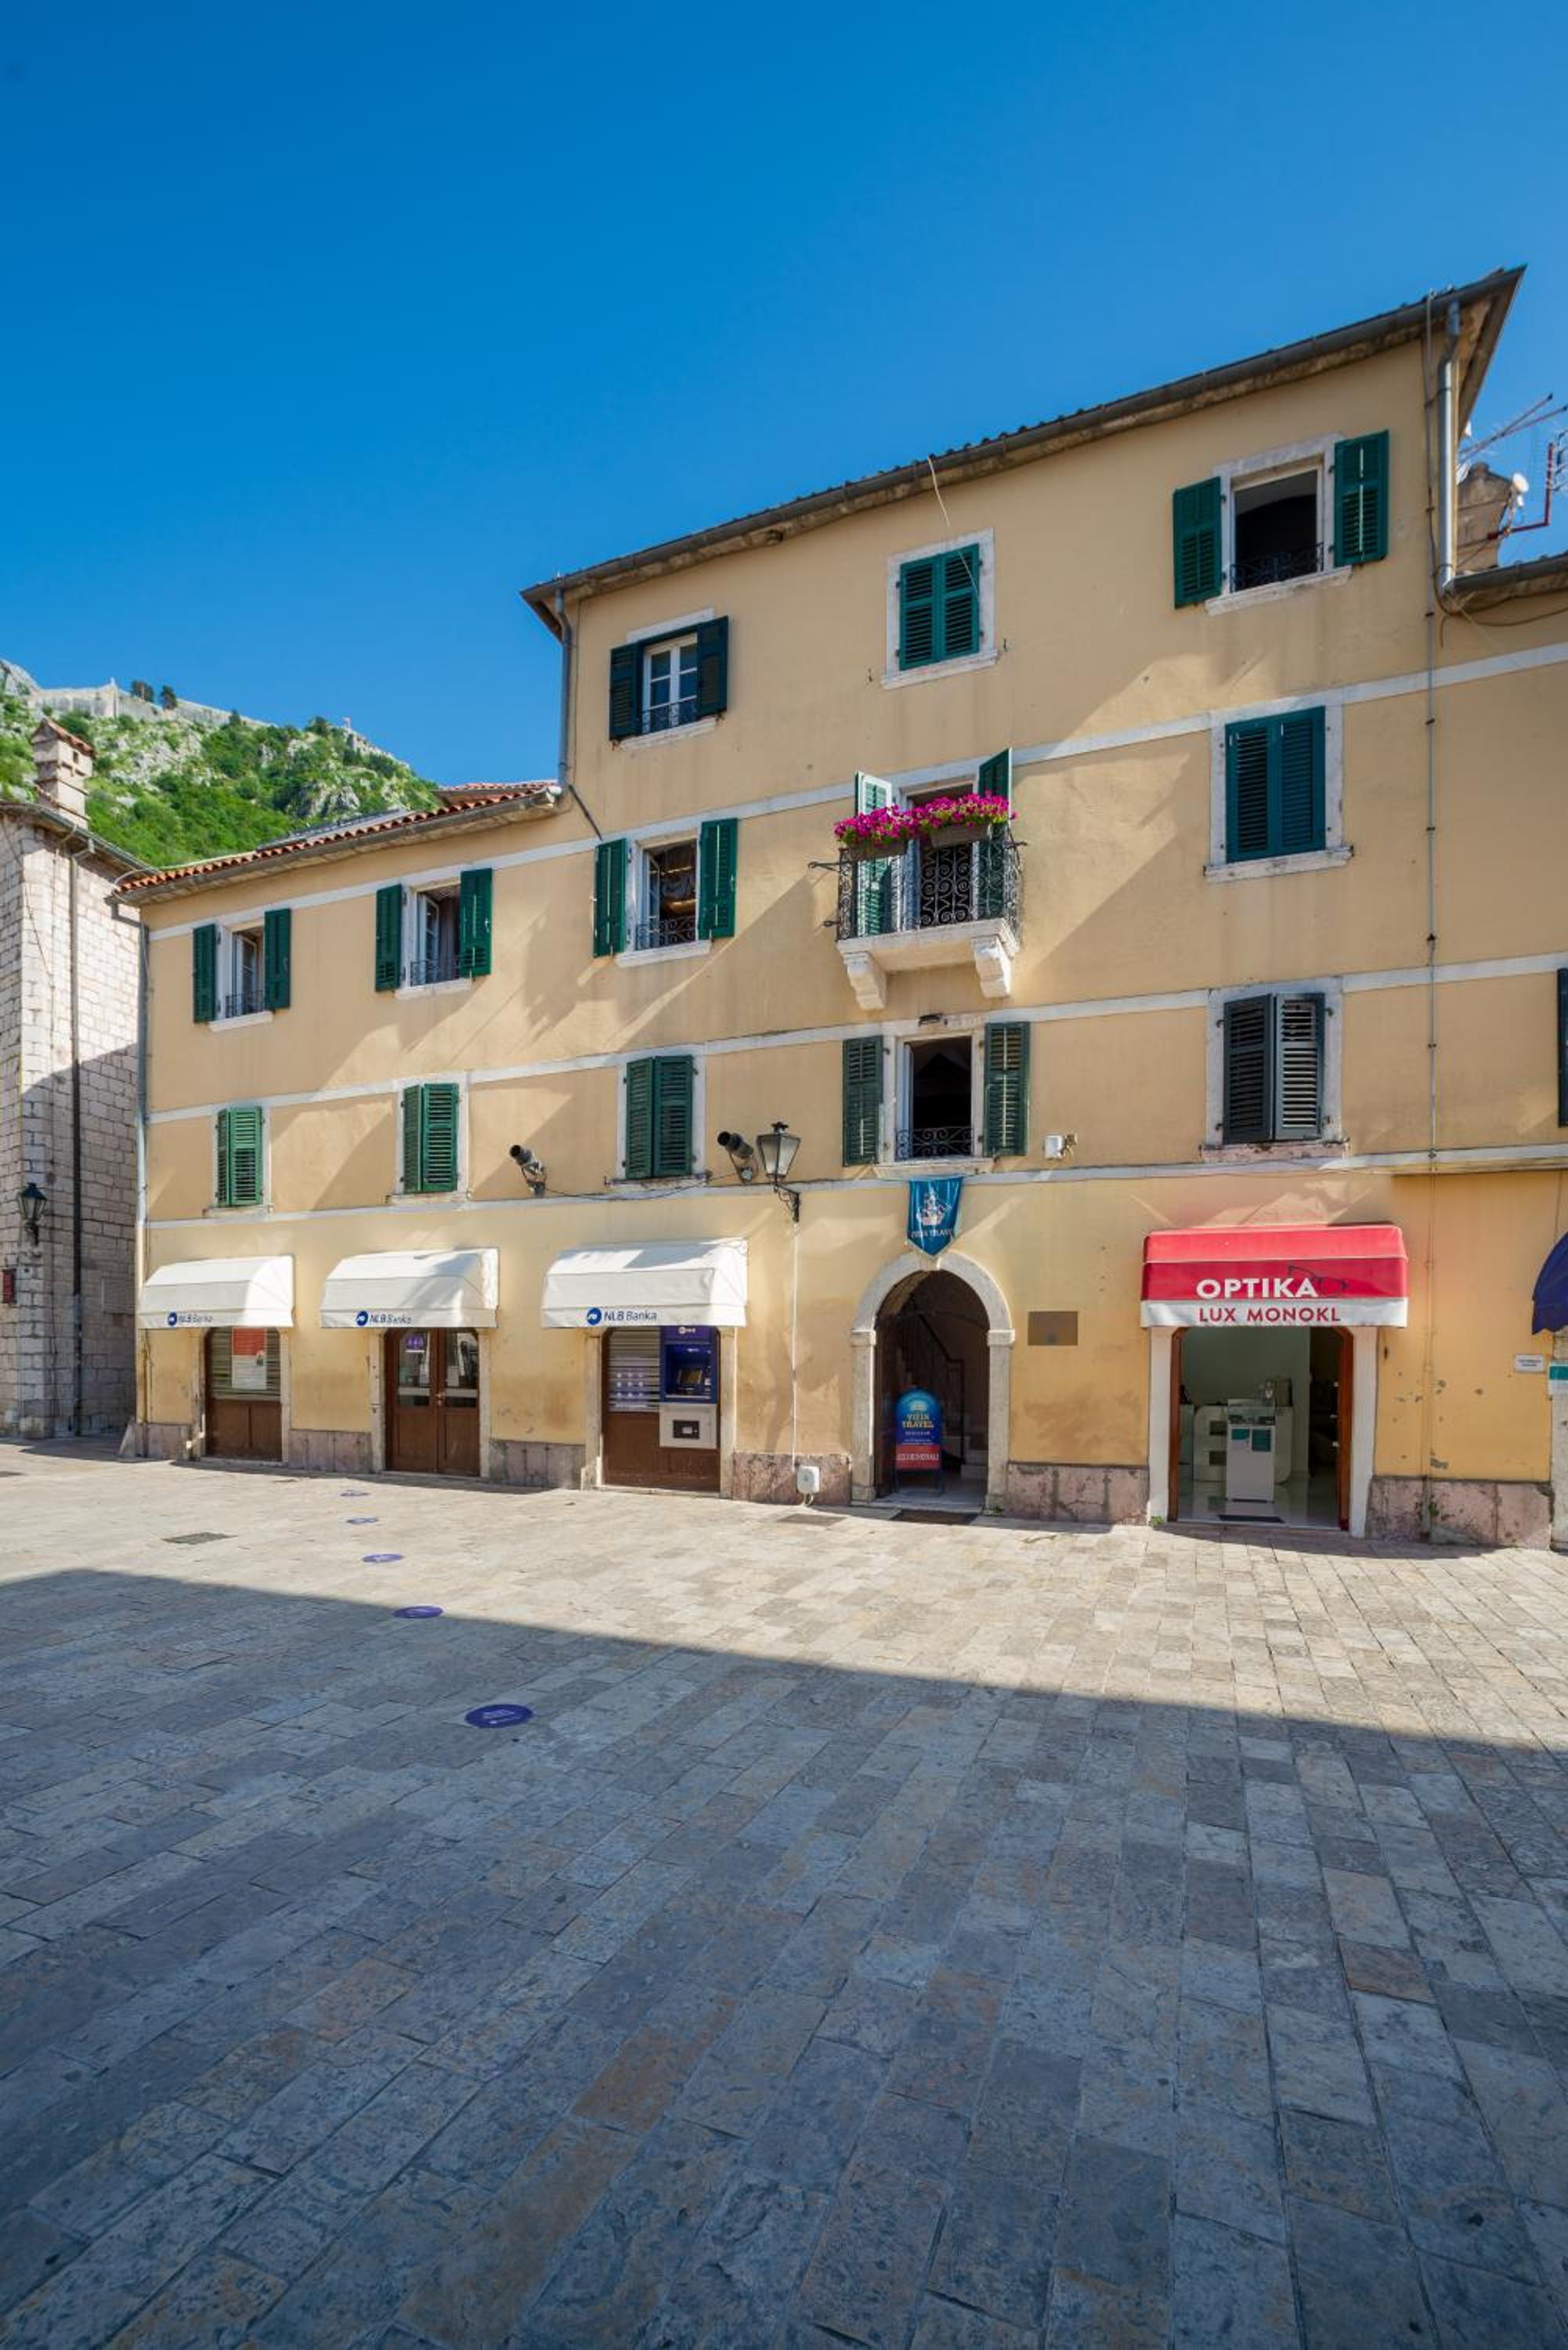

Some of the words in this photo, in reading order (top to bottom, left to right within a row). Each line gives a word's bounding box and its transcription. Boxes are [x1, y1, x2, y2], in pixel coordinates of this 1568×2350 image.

[1196, 1278, 1319, 1300] OPTIKA
[370, 1314, 386, 1323] NLB
[604, 1311, 624, 1321] NLB
[626, 1310, 657, 1322] Banka
[1199, 1307, 1236, 1321] LUX
[1247, 1307, 1341, 1322] MONOKL
